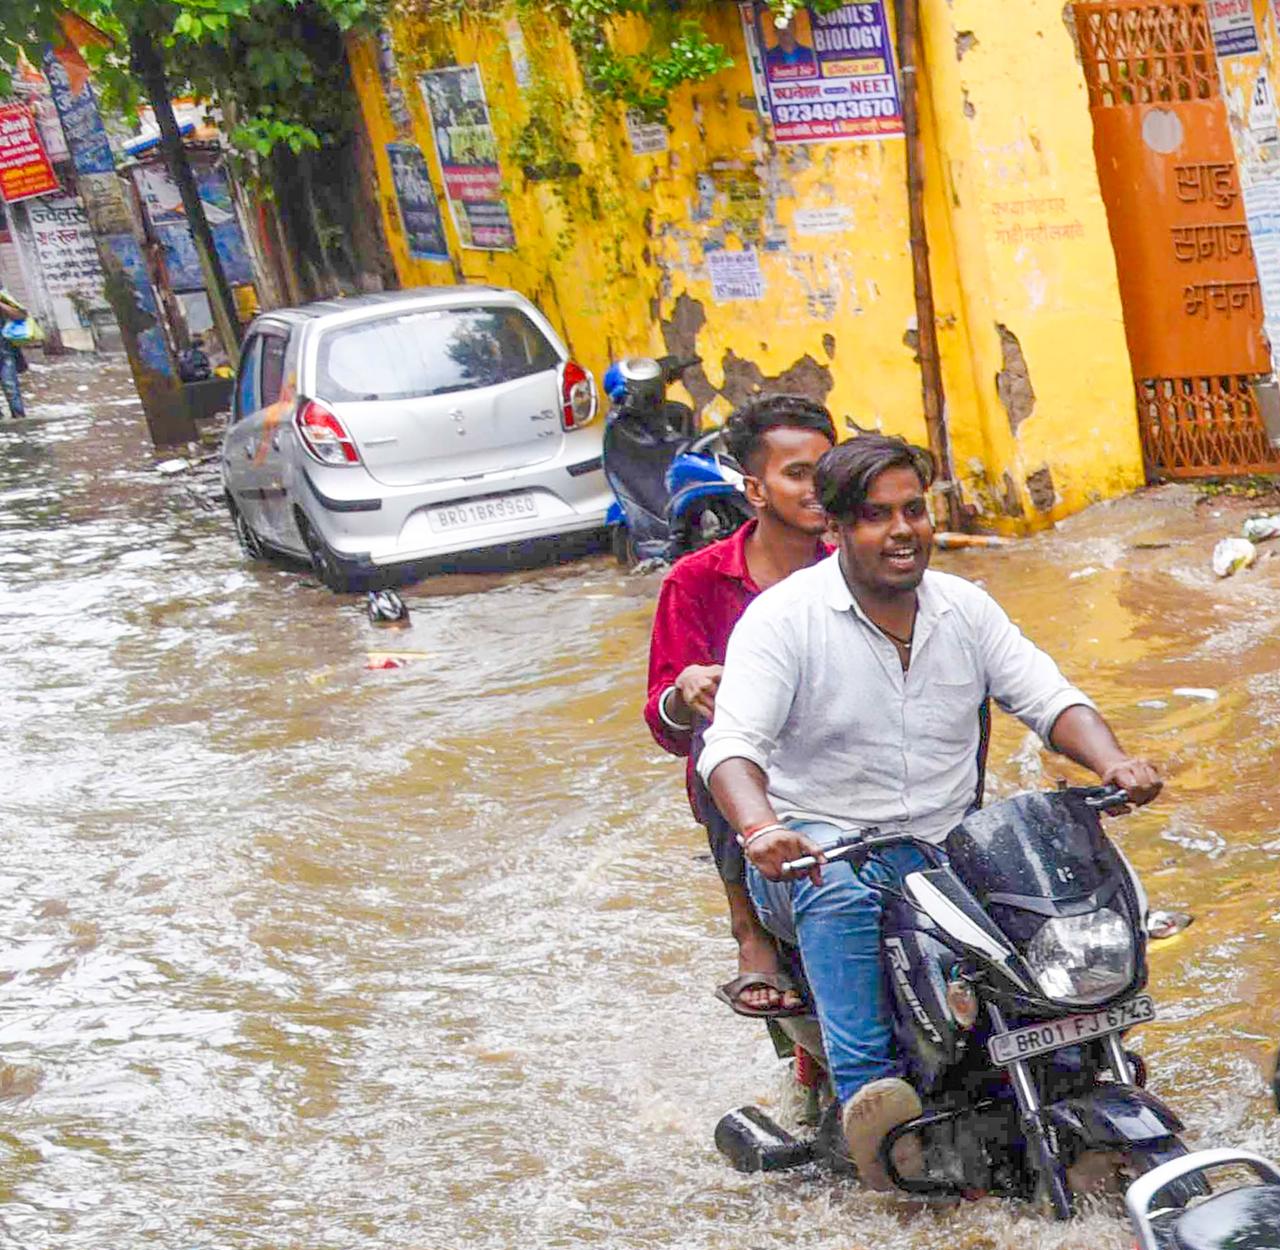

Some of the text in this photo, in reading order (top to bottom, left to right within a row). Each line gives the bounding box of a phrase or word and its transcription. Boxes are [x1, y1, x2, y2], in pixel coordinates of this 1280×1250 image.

[815, 25, 883, 52] BIOLOGY
[850, 79, 891, 96] NEET
[776, 99, 895, 123] 9234943670
[1015, 1023, 1066, 1052] BR01
[1072, 1014, 1101, 1037] FJ
